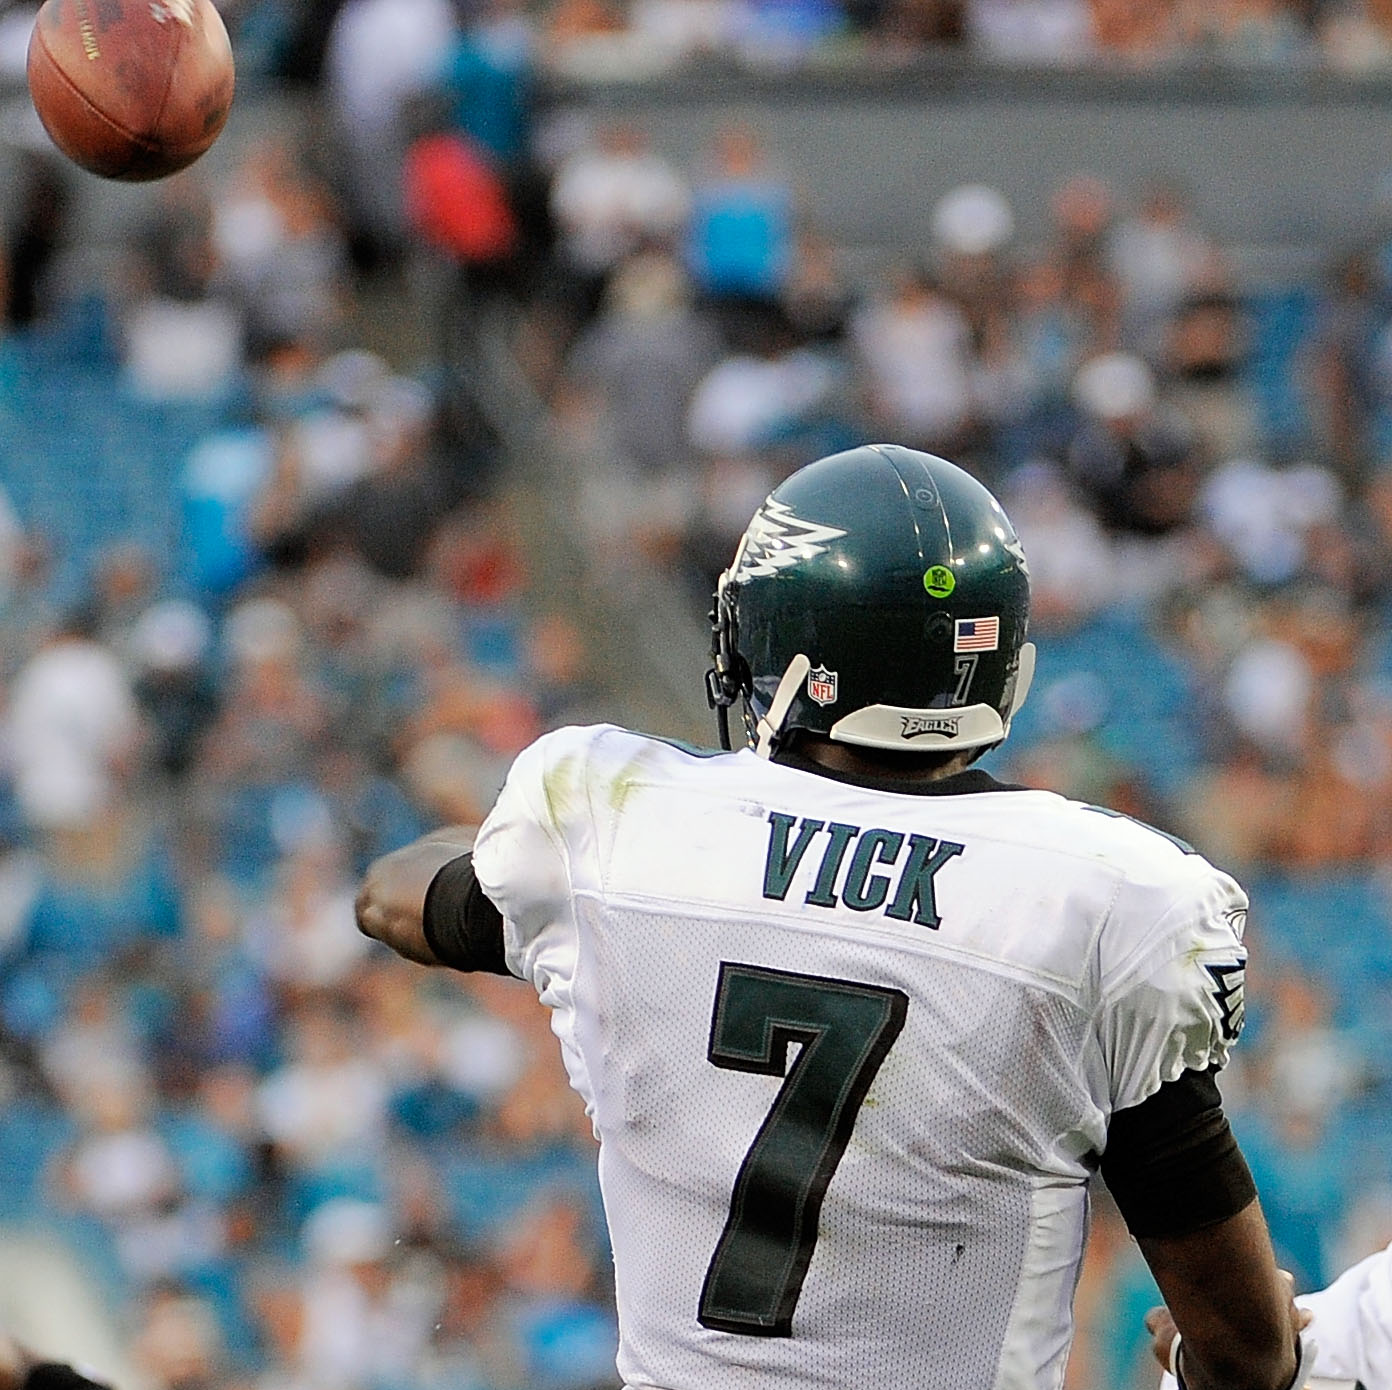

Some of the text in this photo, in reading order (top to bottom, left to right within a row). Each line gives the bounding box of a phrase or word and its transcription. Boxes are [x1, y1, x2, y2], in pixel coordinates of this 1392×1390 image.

[812, 682, 834, 699] NFL
[951, 654, 979, 706] 7
[901, 715, 962, 740] EAGLES
[762, 811, 966, 931] VICK
[698, 960, 909, 1338] 7
